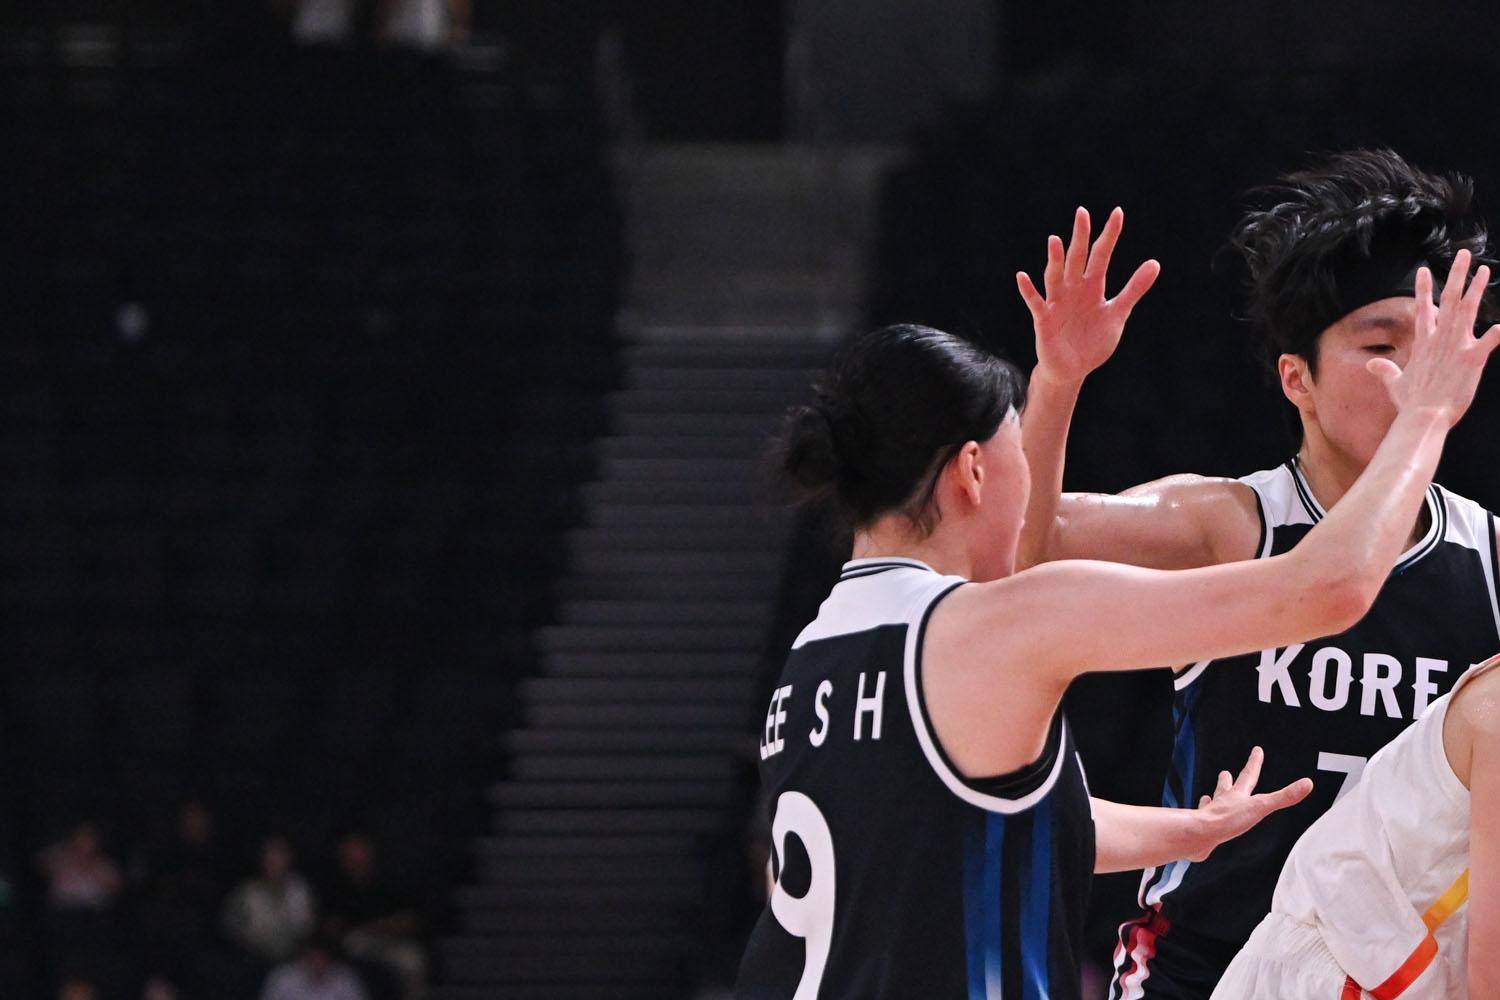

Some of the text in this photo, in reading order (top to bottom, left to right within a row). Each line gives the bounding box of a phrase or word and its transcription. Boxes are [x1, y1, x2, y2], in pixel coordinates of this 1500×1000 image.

[808, 679, 833, 748] S
[853, 671, 887, 741] H
[1256, 643, 1479, 720] KORE
